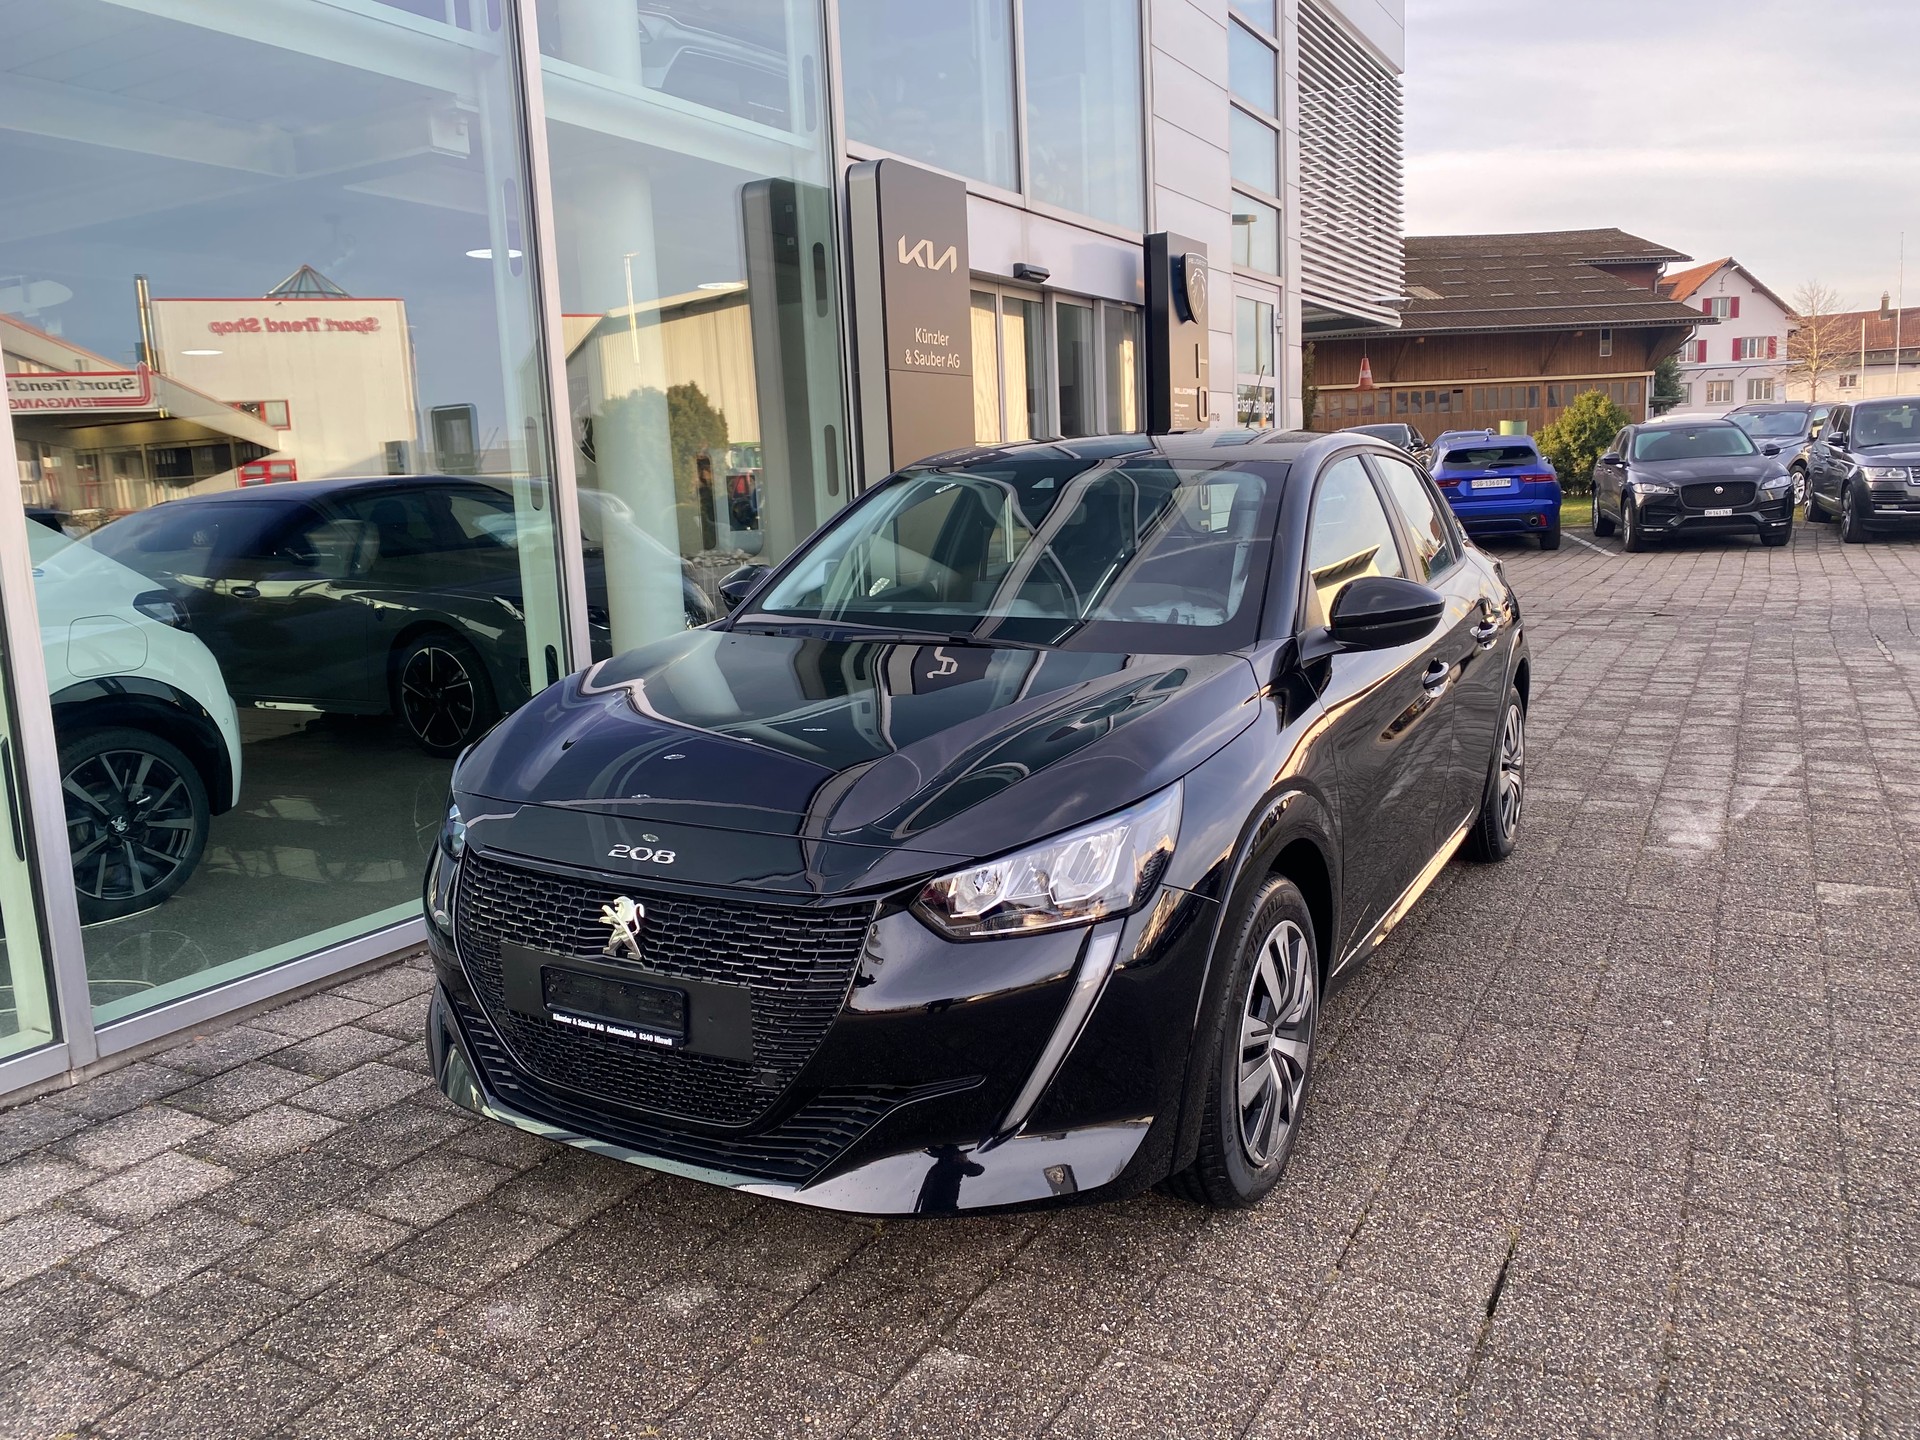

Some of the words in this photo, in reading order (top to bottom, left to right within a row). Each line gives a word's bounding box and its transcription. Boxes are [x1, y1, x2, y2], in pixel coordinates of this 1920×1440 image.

[898, 234, 958, 274] KIA
[914, 327, 950, 346] Künzler
[904, 348, 912, 365] &
[914, 349, 946, 368] Sauber
[946, 353, 961, 369] AG
[607, 844, 676, 864] 208
[639, 1032, 653, 1042] 8340
